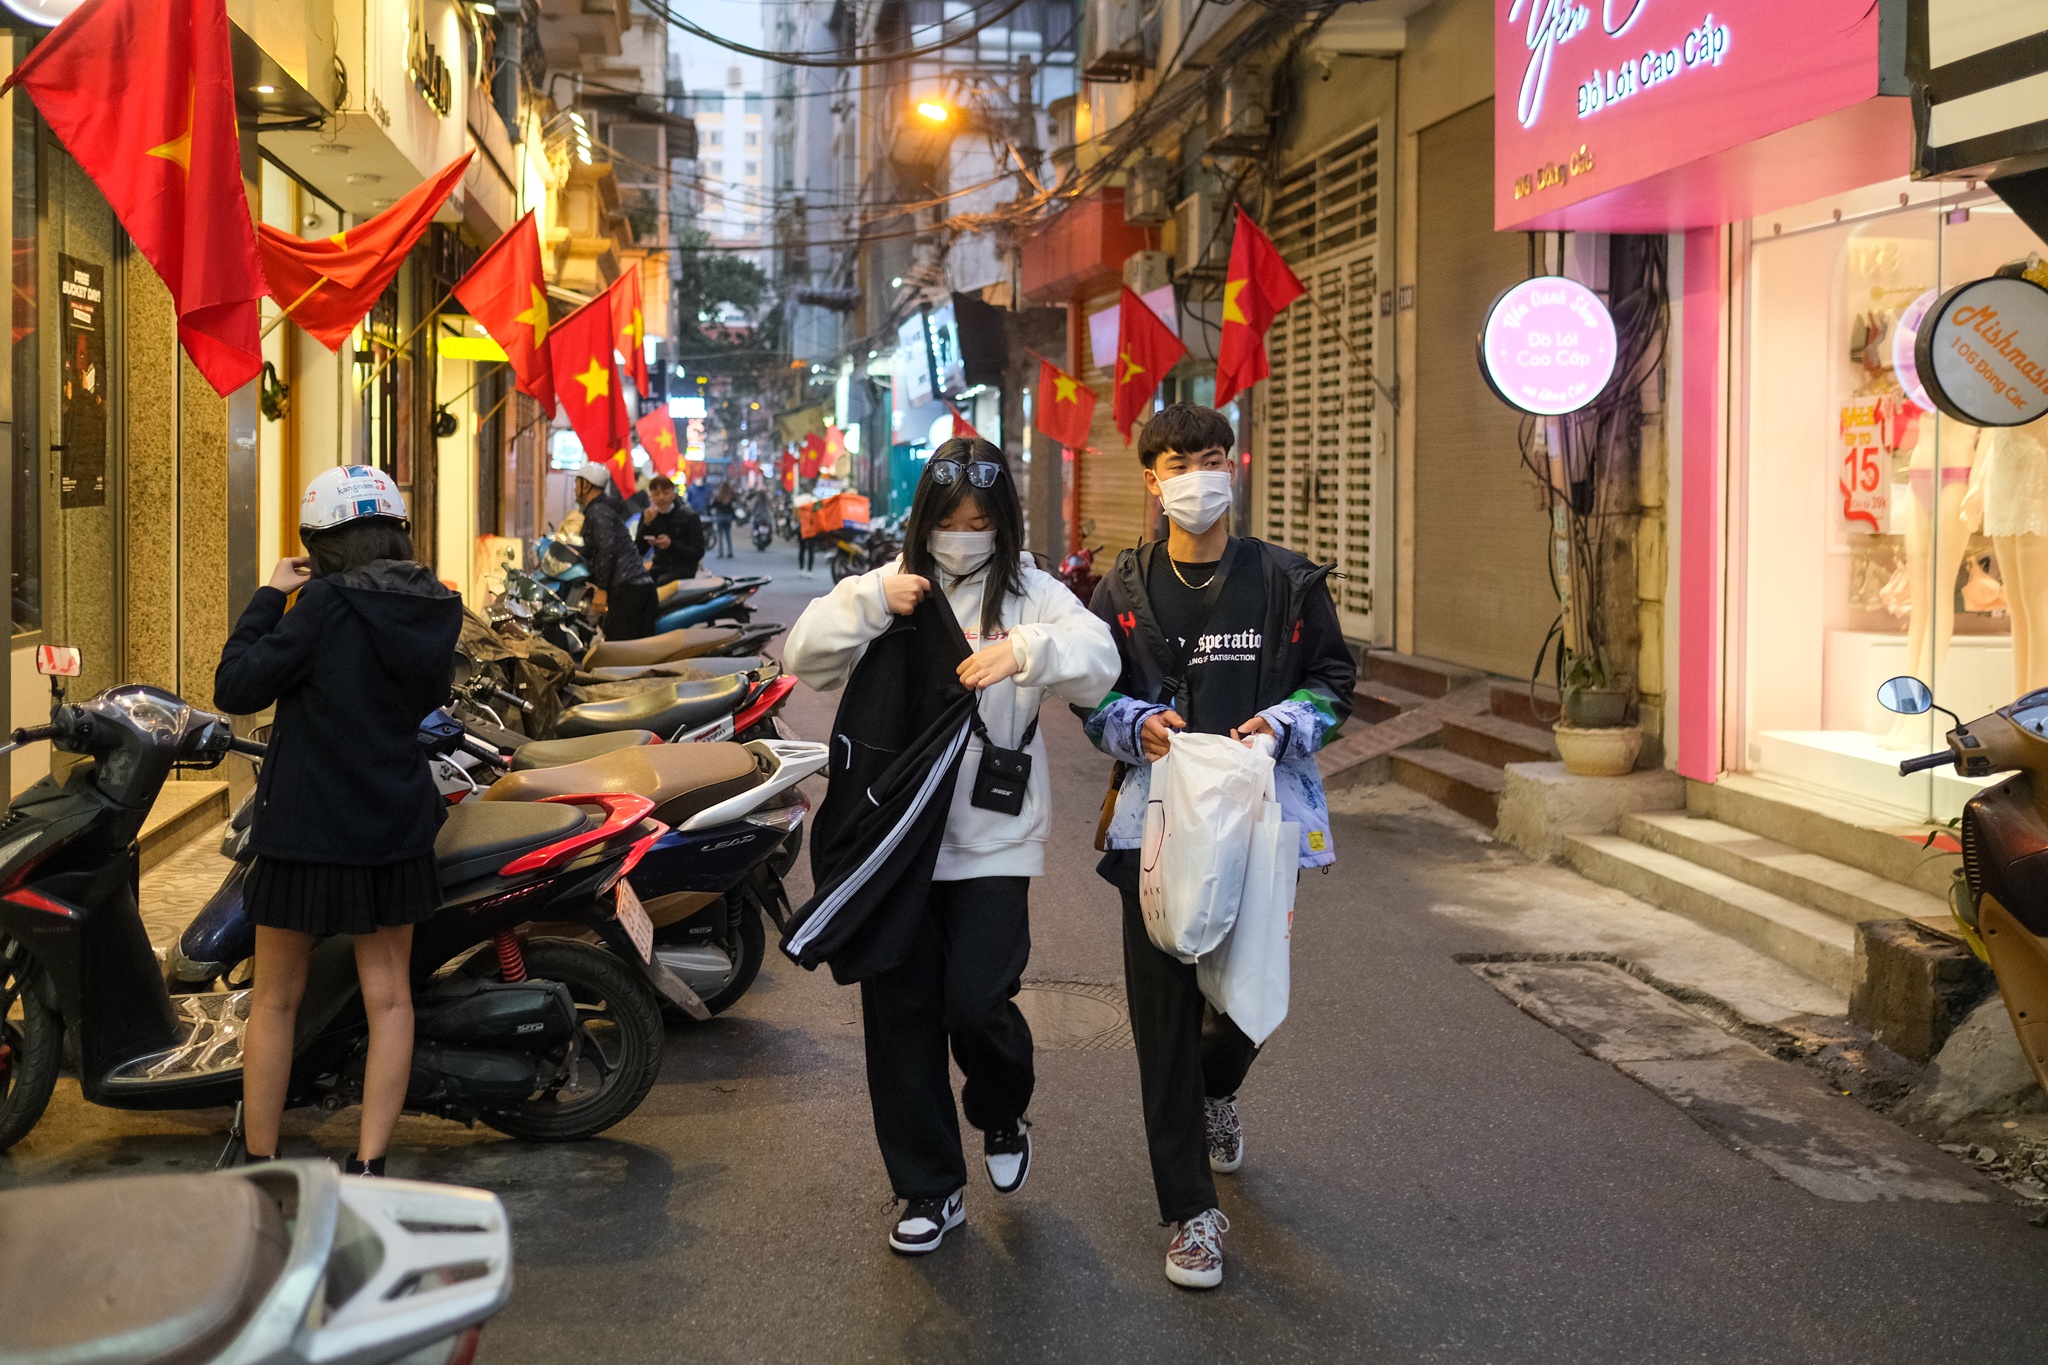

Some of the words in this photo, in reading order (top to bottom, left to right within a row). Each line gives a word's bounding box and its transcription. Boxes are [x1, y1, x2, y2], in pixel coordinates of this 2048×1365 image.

[1578, 69, 1606, 118] Đồ
[1605, 59, 1638, 105] Lót
[1640, 48, 1681, 88] Cao
[1683, 12, 1731, 67] Cấp
[74, 270, 90, 286] FREE
[62, 280, 88, 299] BUCKET
[1530, 287, 1567, 308] Oanh
[1569, 295, 1598, 328] Shop
[1516, 350, 1552, 367] Cao
[1951, 336, 1980, 365] 106
[1841, 405, 1875, 428] SALE
[1859, 432, 1872, 445] TO
[1845, 447, 1880, 492] 15
[337, 483, 374, 495] kangnam
[1194, 628, 1262, 653] speratio
[1209, 653, 1256, 661] SATISFACTION
[701, 834, 756, 852] LEAD
